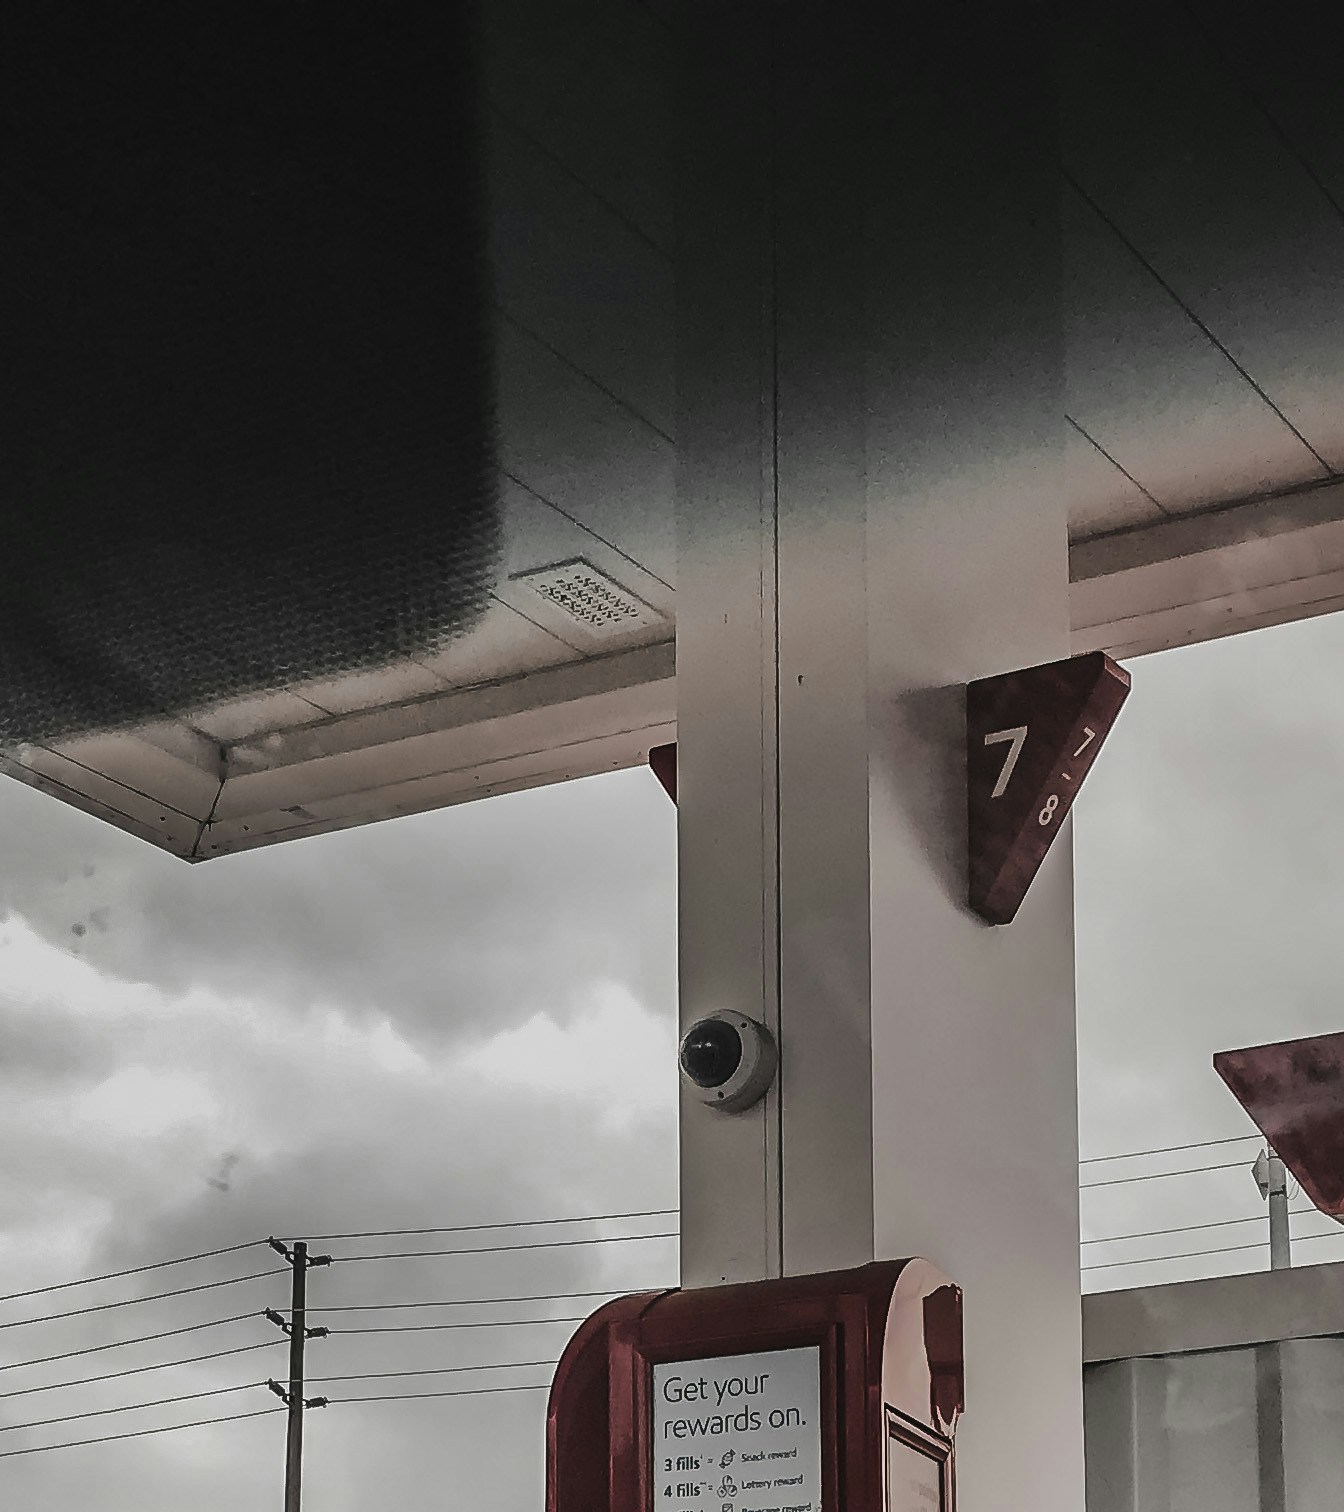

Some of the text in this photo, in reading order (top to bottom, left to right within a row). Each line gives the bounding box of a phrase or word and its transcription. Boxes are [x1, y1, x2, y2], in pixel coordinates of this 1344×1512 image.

[984, 725, 1028, 798] 7
[663, 1374, 770, 1406] Get your
[664, 1405, 806, 1439] rewards on.
[768, 1447, 797, 1460] reward
[664, 1458, 672, 1471] 3
[774, 1474, 803, 1487] reward
[664, 1485, 672, 1497] 4
